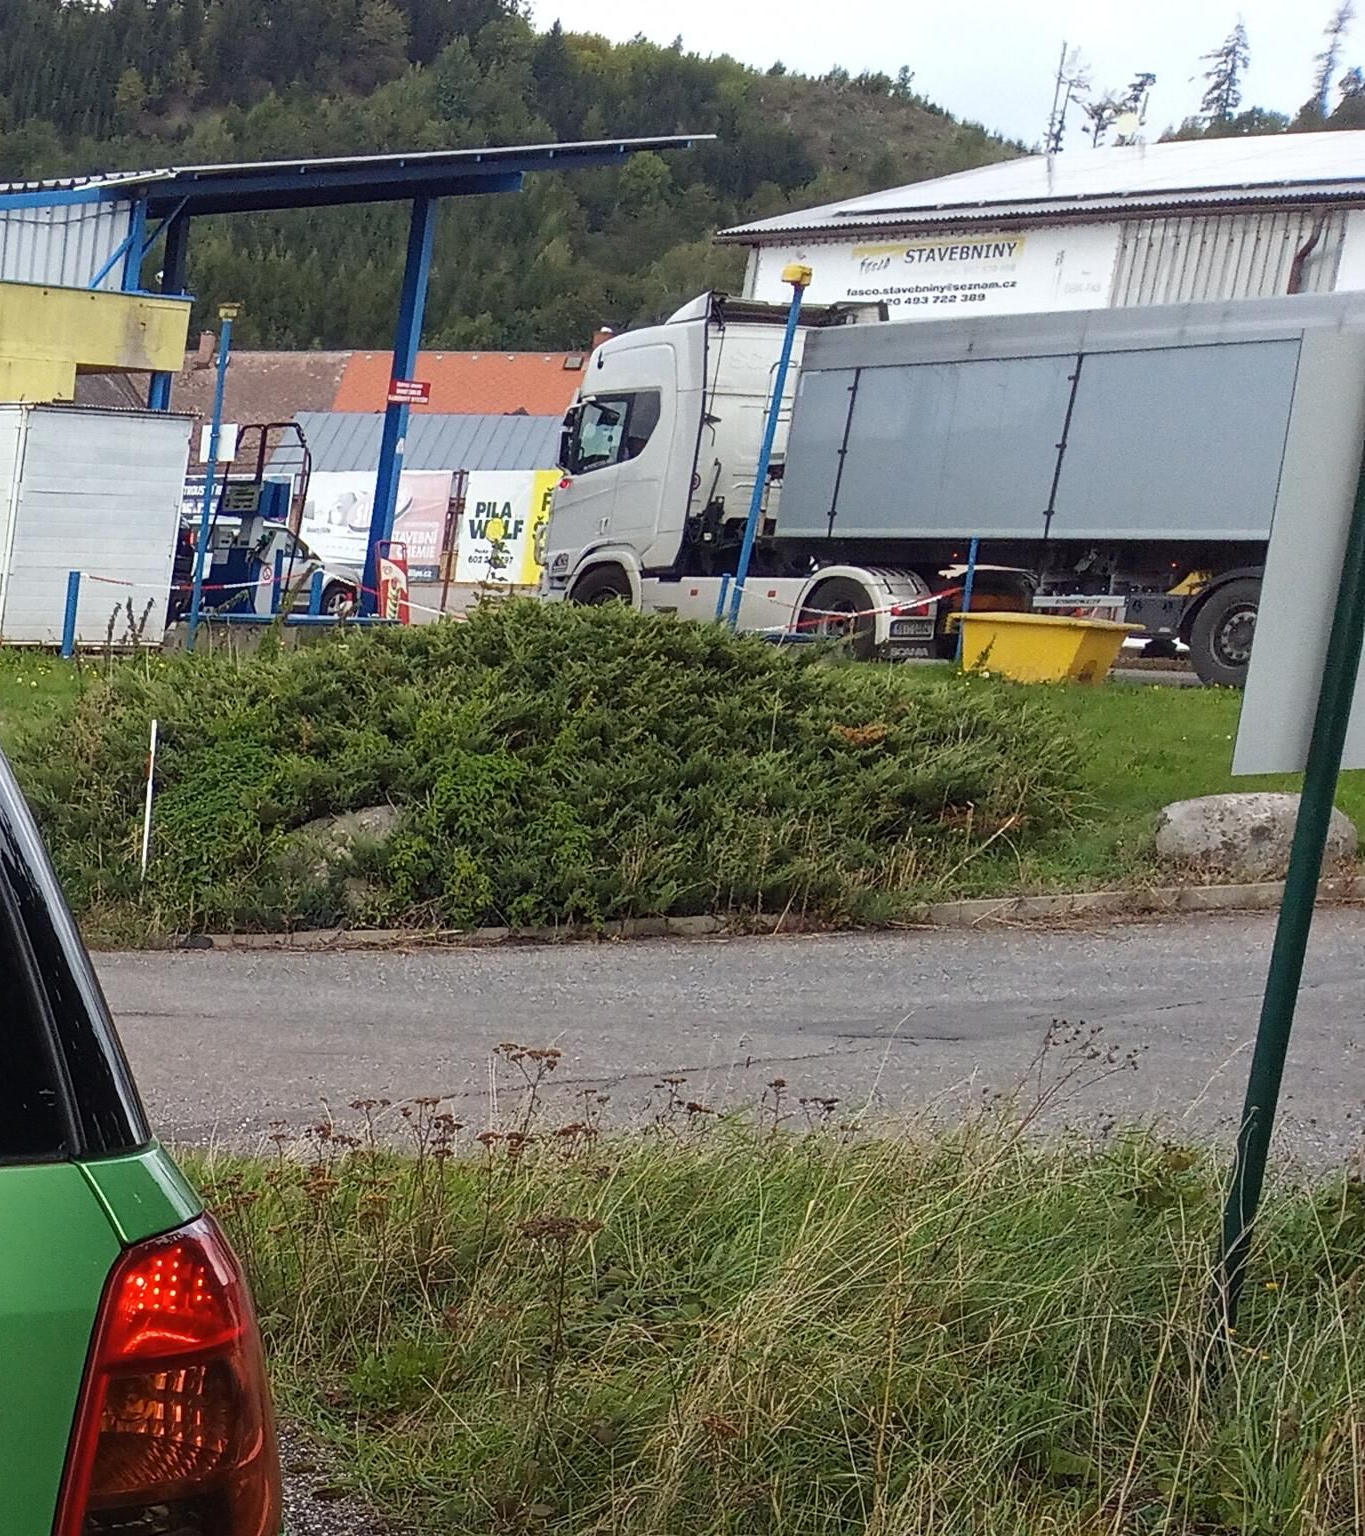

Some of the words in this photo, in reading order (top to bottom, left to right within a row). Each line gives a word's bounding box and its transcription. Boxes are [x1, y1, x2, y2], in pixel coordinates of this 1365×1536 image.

[904, 242, 1018, 264] STAVEBNINY
[904, 295, 929, 305] 493
[933, 294, 957, 304] 722
[960, 293, 986, 303] 389
[475, 501, 512, 519] PILA
[468, 519, 525, 540] WLF
